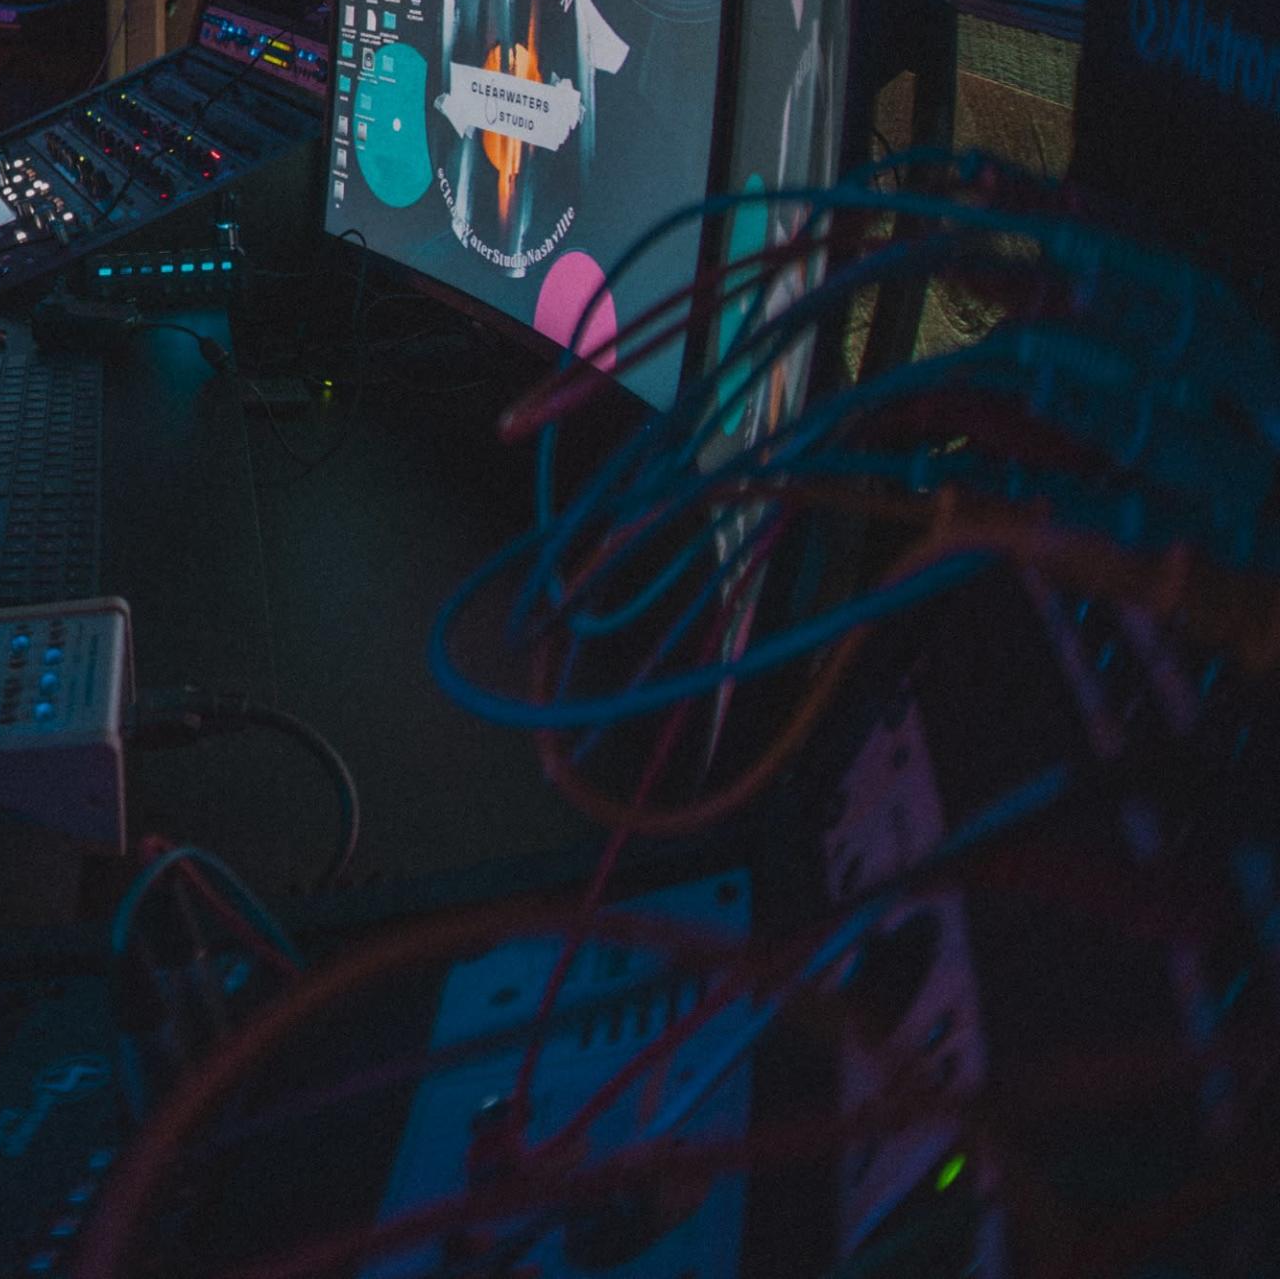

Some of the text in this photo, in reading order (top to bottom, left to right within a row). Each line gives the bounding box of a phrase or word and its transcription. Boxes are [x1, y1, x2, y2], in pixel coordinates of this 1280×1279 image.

[471, 81, 550, 113] CLEARWATERS
[499, 111, 535, 131] STUDIO
[438, 168, 575, 268] @CleaWaterStudioNashville
